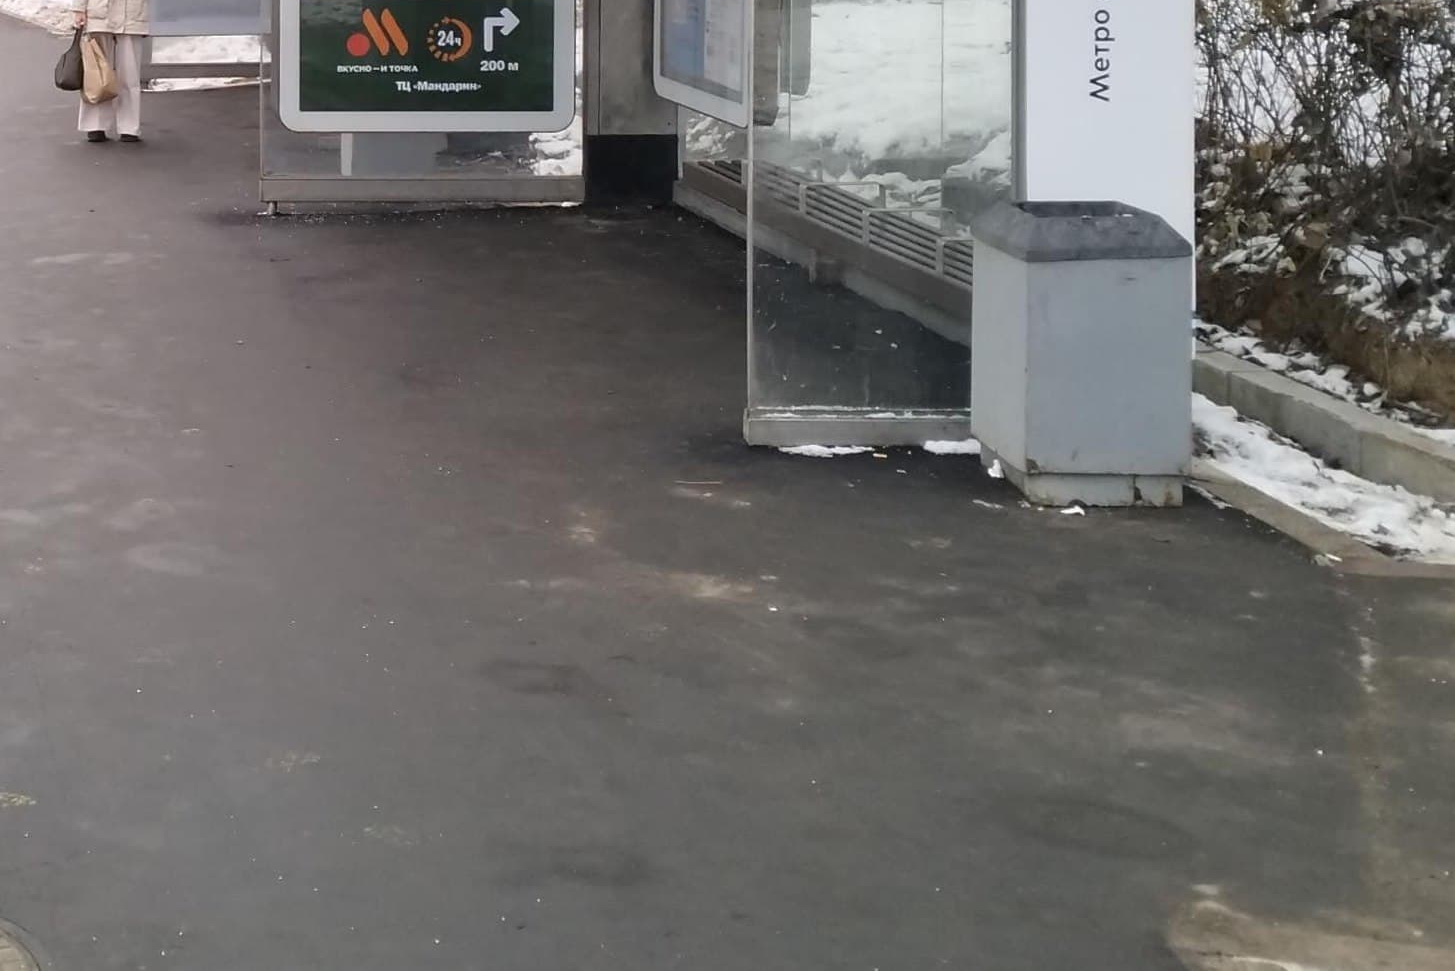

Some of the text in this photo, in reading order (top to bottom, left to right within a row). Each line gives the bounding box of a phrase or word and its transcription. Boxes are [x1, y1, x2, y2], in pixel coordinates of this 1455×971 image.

[1088, 9, 1115, 102] Метро
[337, 65, 372, 73] ВКУСНО
[480, 60, 506, 71] 200
[396, 81, 482, 93] ТЦ «Мандарин»
